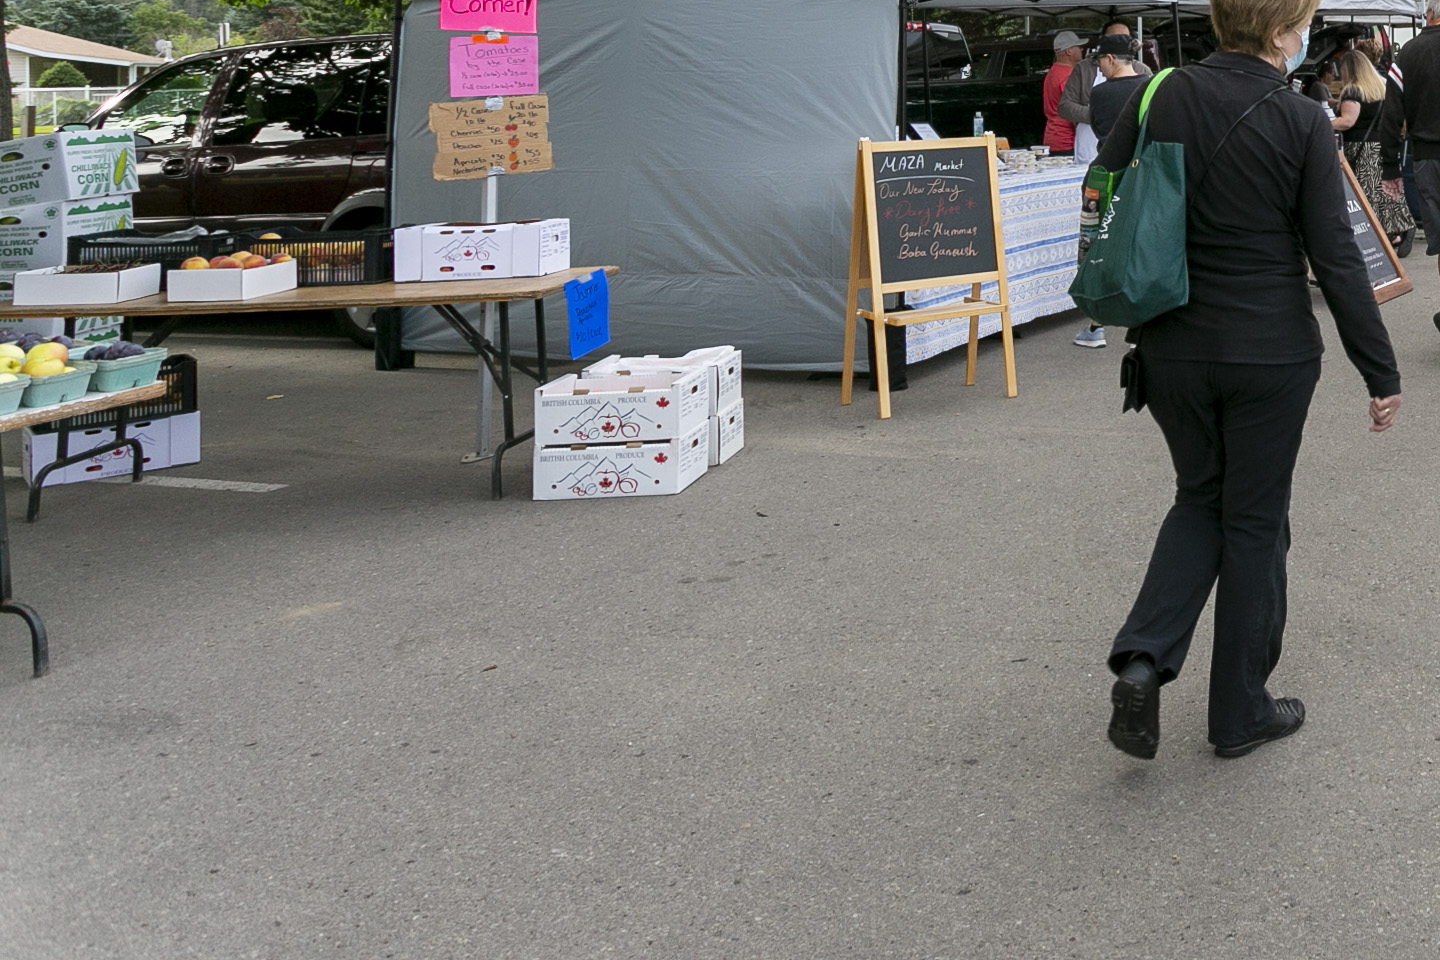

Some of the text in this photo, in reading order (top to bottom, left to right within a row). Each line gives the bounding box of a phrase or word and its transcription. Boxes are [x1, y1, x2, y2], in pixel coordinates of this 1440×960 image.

[457, 43, 529, 58] Tomatoes
[466, 60, 480, 70] by
[450, 129, 484, 138] Cherries
[71, 162, 112, 173] CHILLIWACK
[880, 154, 965, 173] MAZA Market
[0, 171, 44, 184] HILLIWACK
[77, 173, 109, 185] CORN
[0, 180, 40, 194] CORN
[880, 178, 965, 202] Our New Today
[899, 222, 978, 242] Garlic Hummus
[897, 244, 928, 260] Baba
[542, 396, 647, 408] BRITISH COLUMBIA PRODUCE
[566, 453, 599, 462] COLUMBIA
[616, 452, 645, 460] PRODUCE
[100, 468, 133, 476] PRODUC
